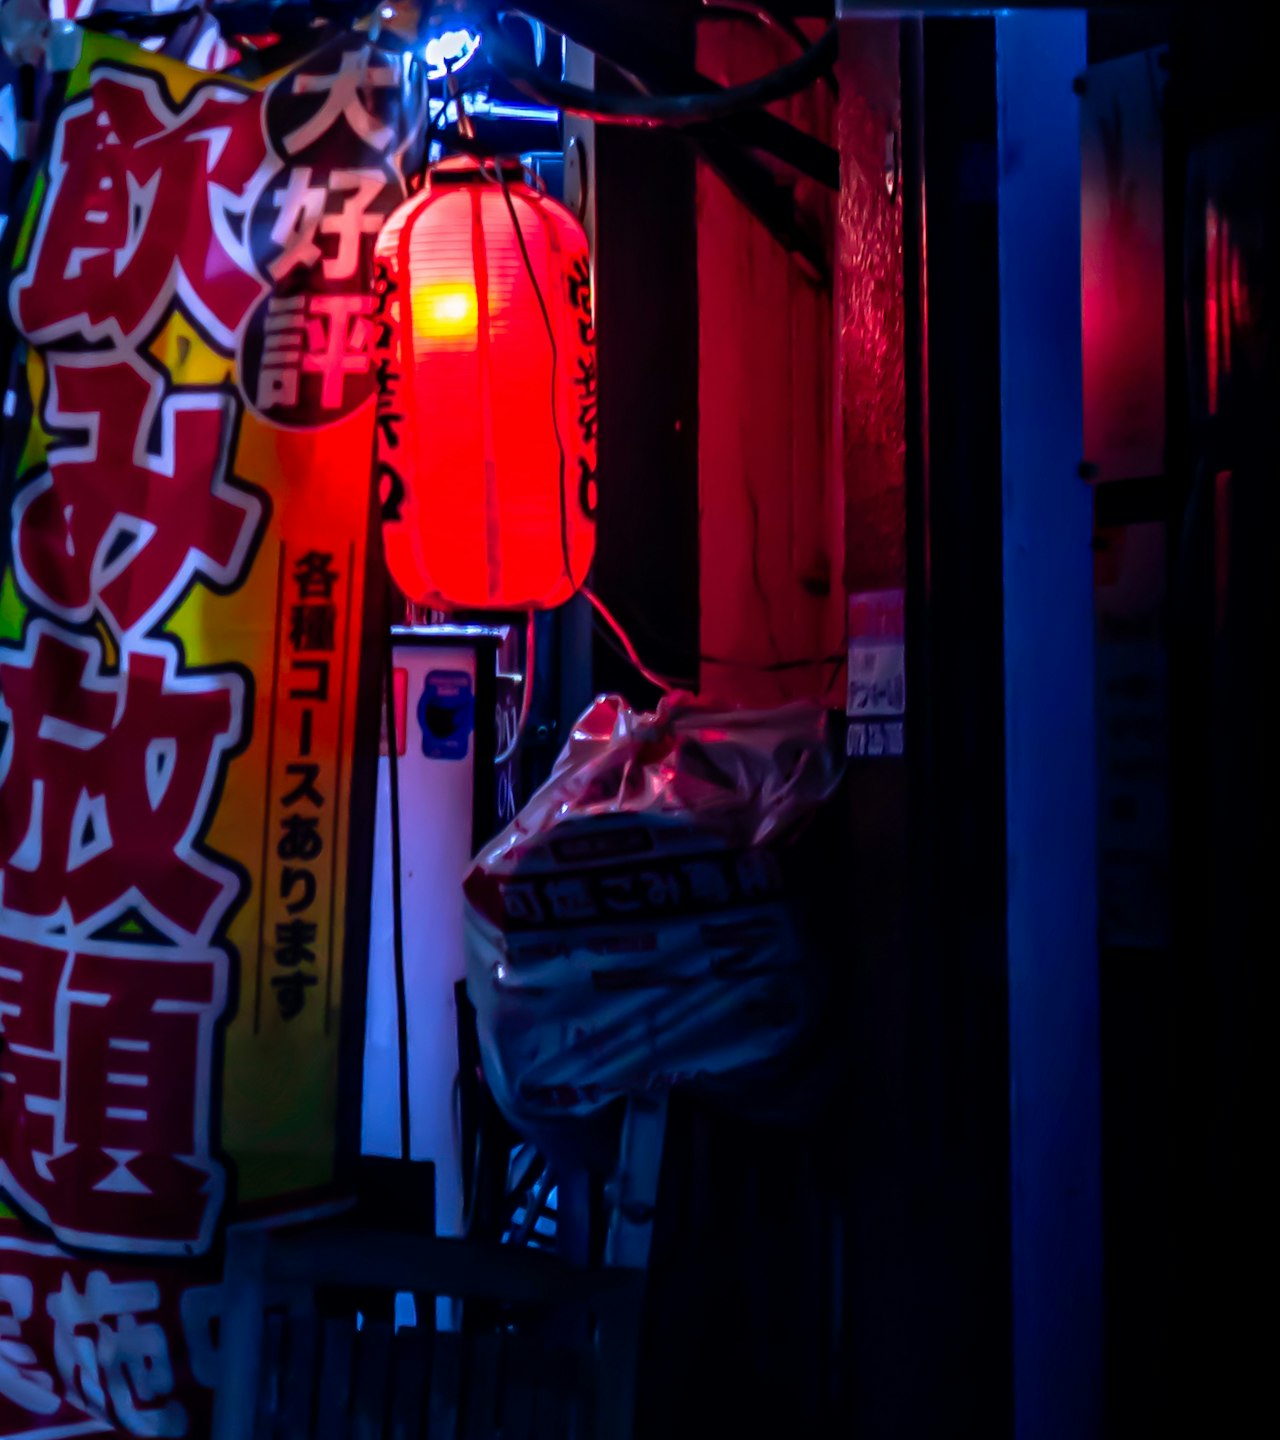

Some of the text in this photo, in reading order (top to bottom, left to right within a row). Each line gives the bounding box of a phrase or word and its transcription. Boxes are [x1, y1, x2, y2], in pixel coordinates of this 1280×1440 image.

[255, 48, 398, 410] 大好評
[272, 550, 343, 1021] 各種コースあります
